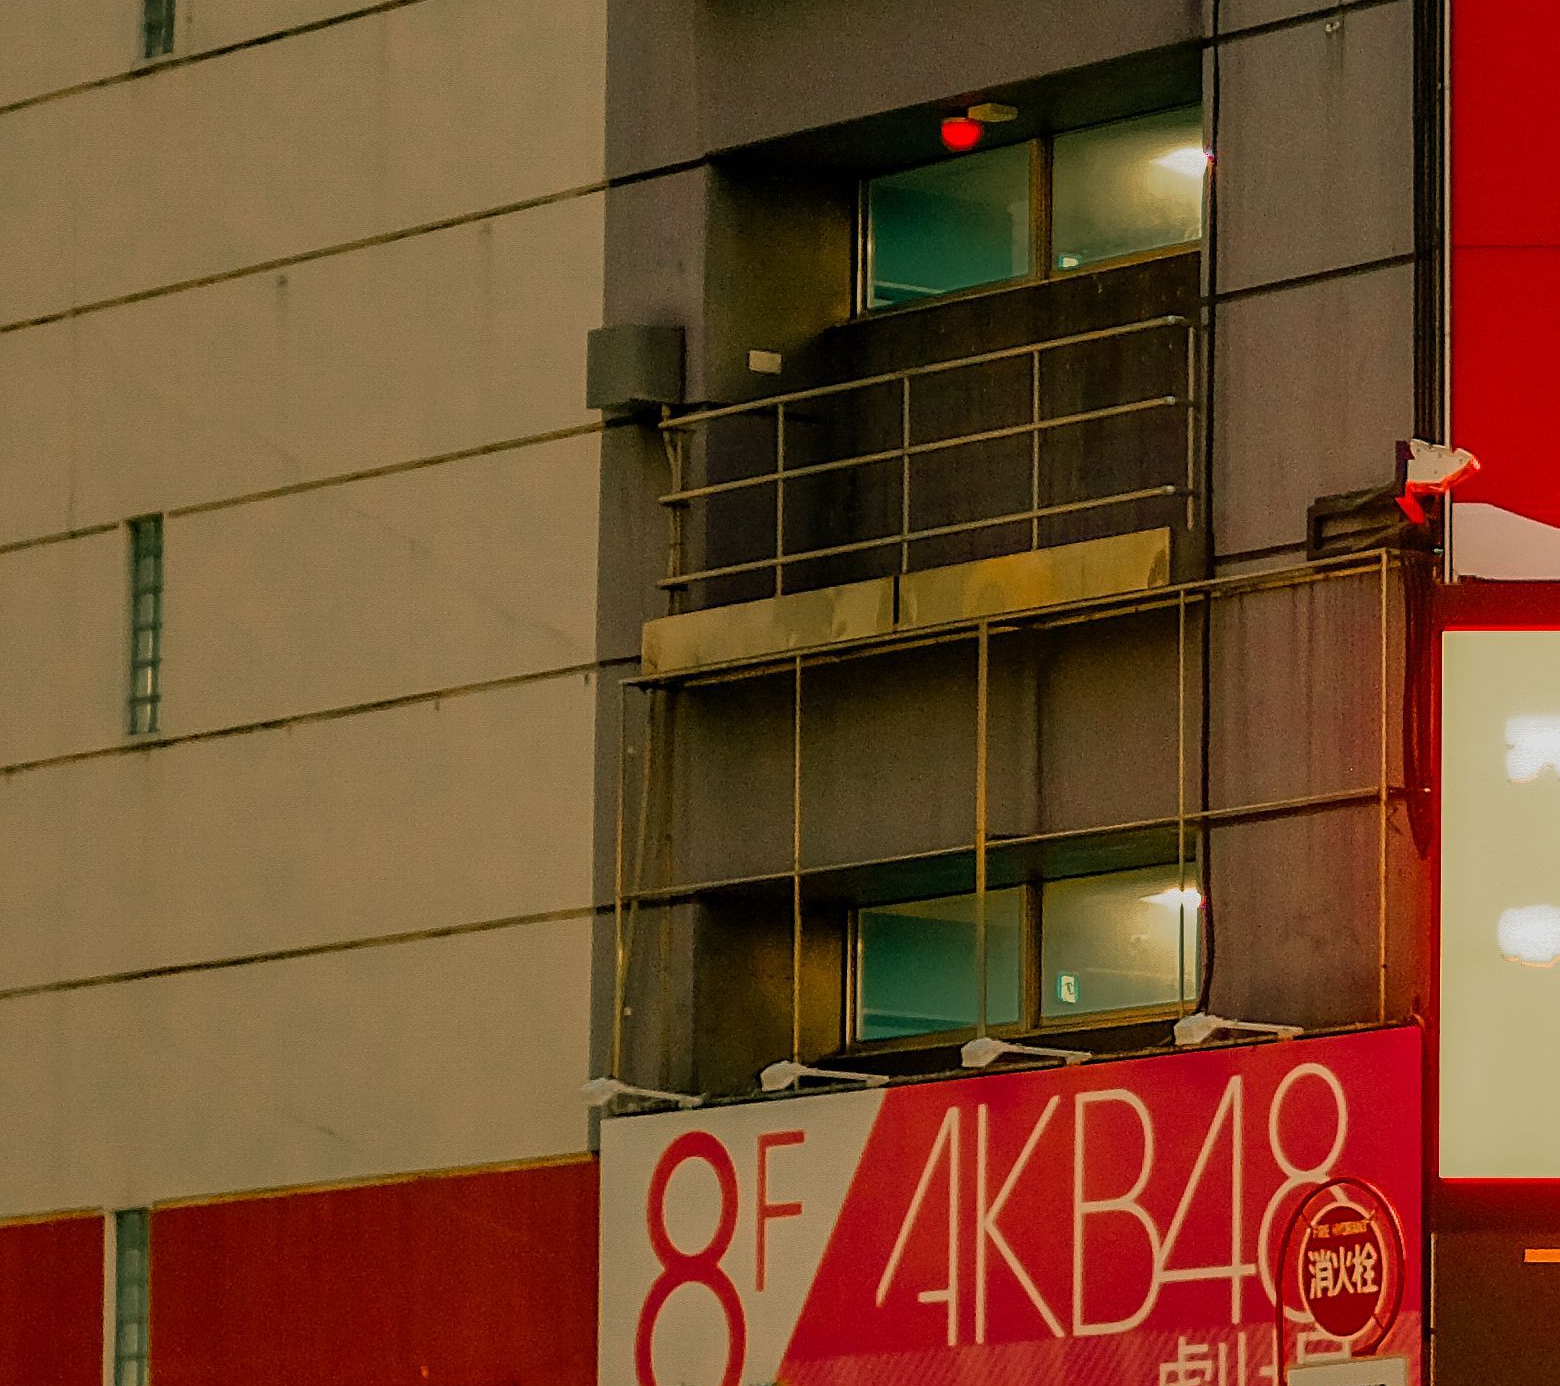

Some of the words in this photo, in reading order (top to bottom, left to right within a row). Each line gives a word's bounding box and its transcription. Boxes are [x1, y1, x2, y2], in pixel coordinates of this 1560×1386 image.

[876, 1061, 1349, 1347] AKB48
[1308, 1242, 1379, 1299] 消火栓
